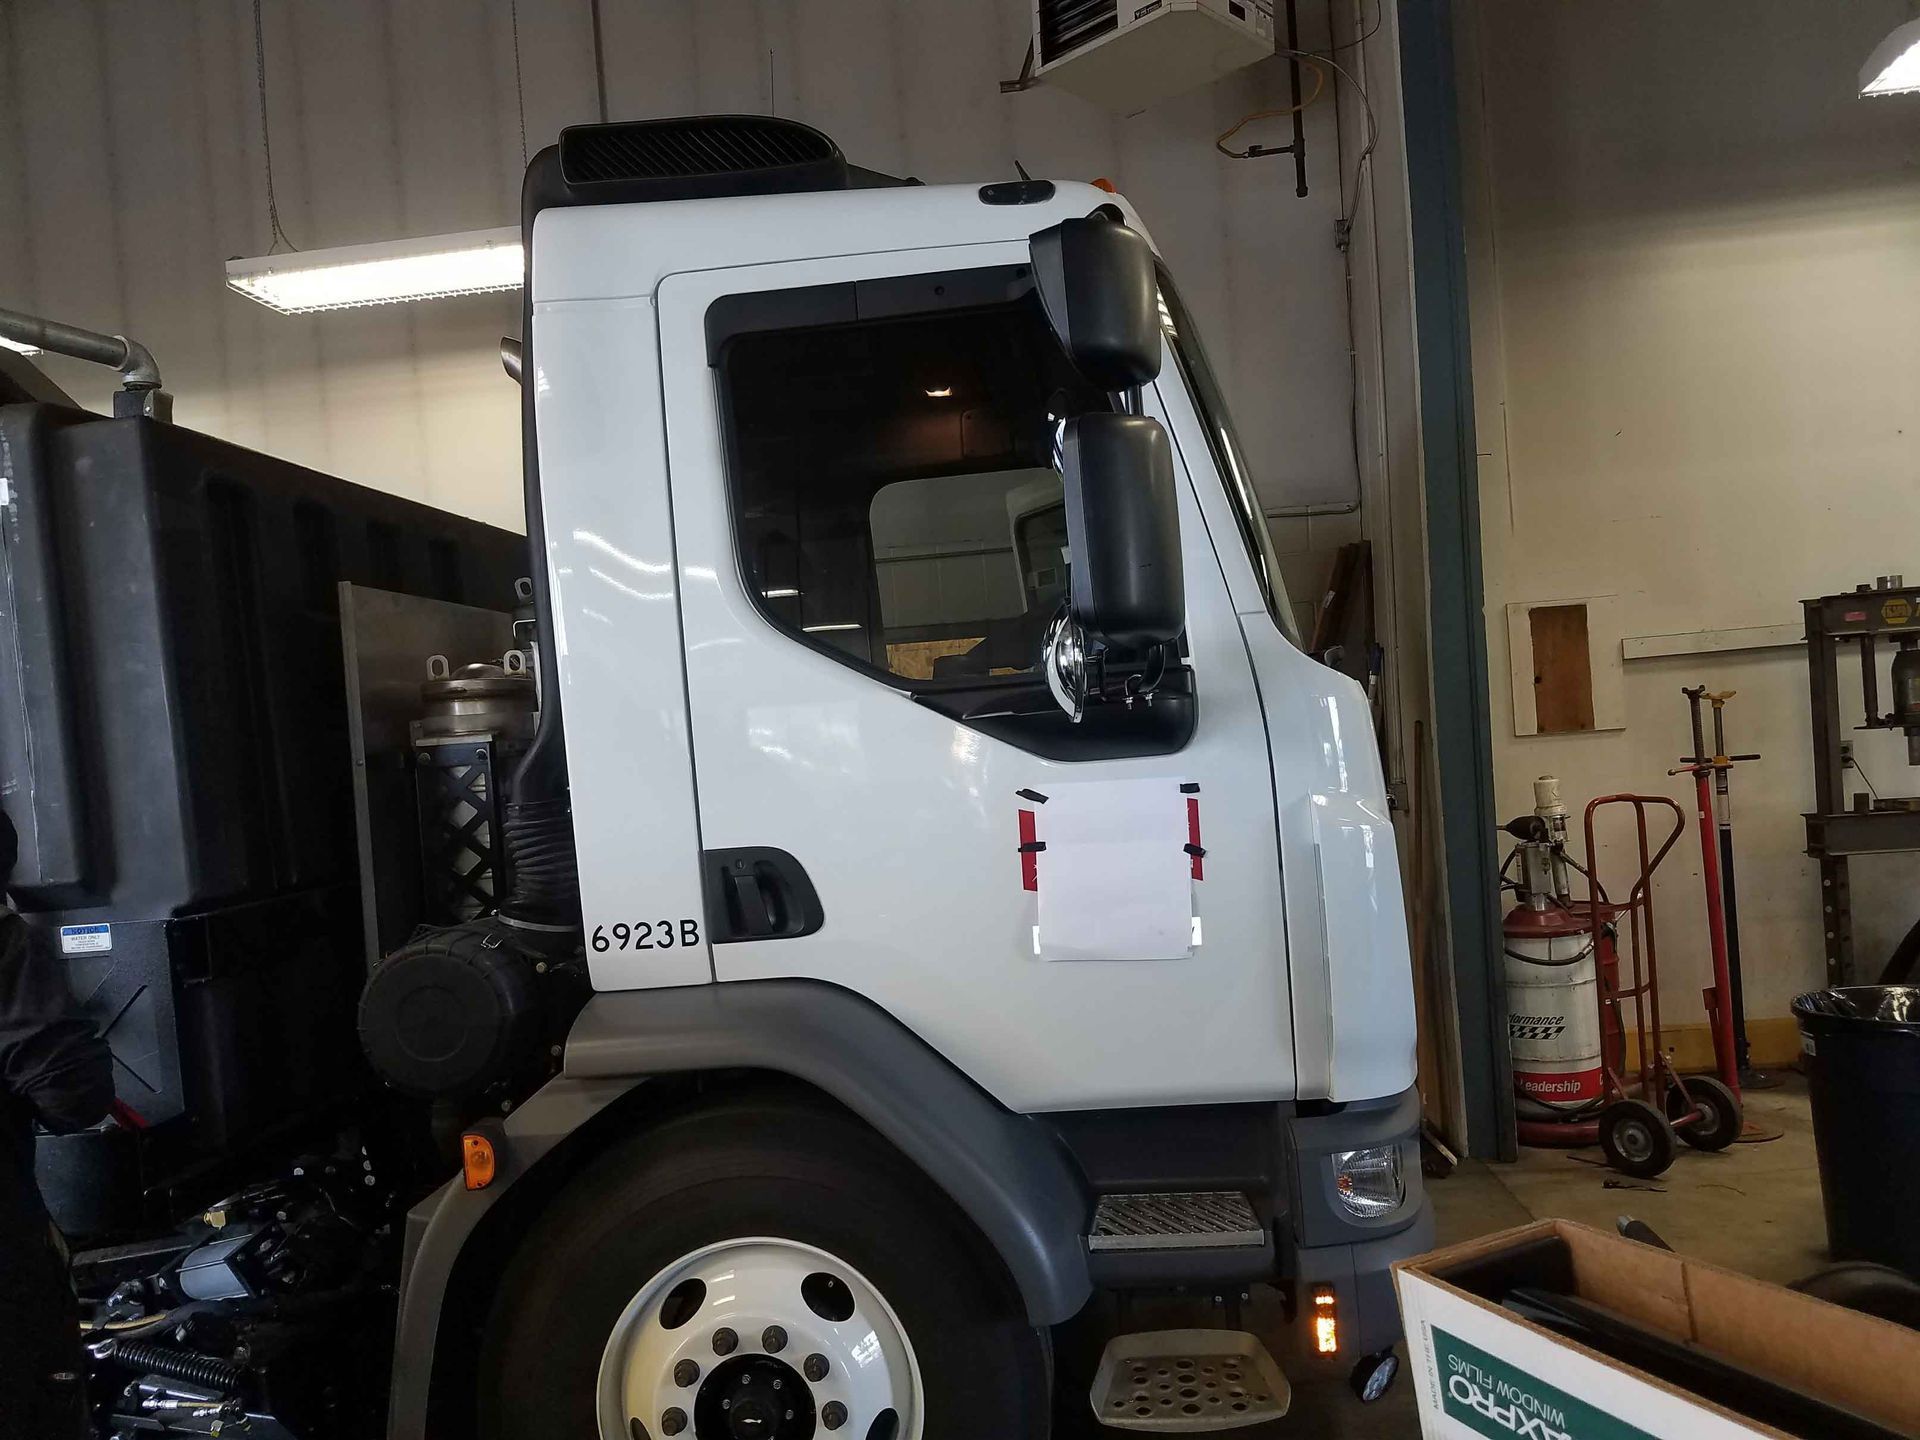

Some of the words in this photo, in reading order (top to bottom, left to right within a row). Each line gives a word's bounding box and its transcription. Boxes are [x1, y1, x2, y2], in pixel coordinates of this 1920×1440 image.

[71, 926, 99, 935] NOTICE
[591, 919, 699, 952] 6923B
[1447, 1354, 1492, 1389] FILMS
[1496, 1380, 1565, 1430] WINDOW
